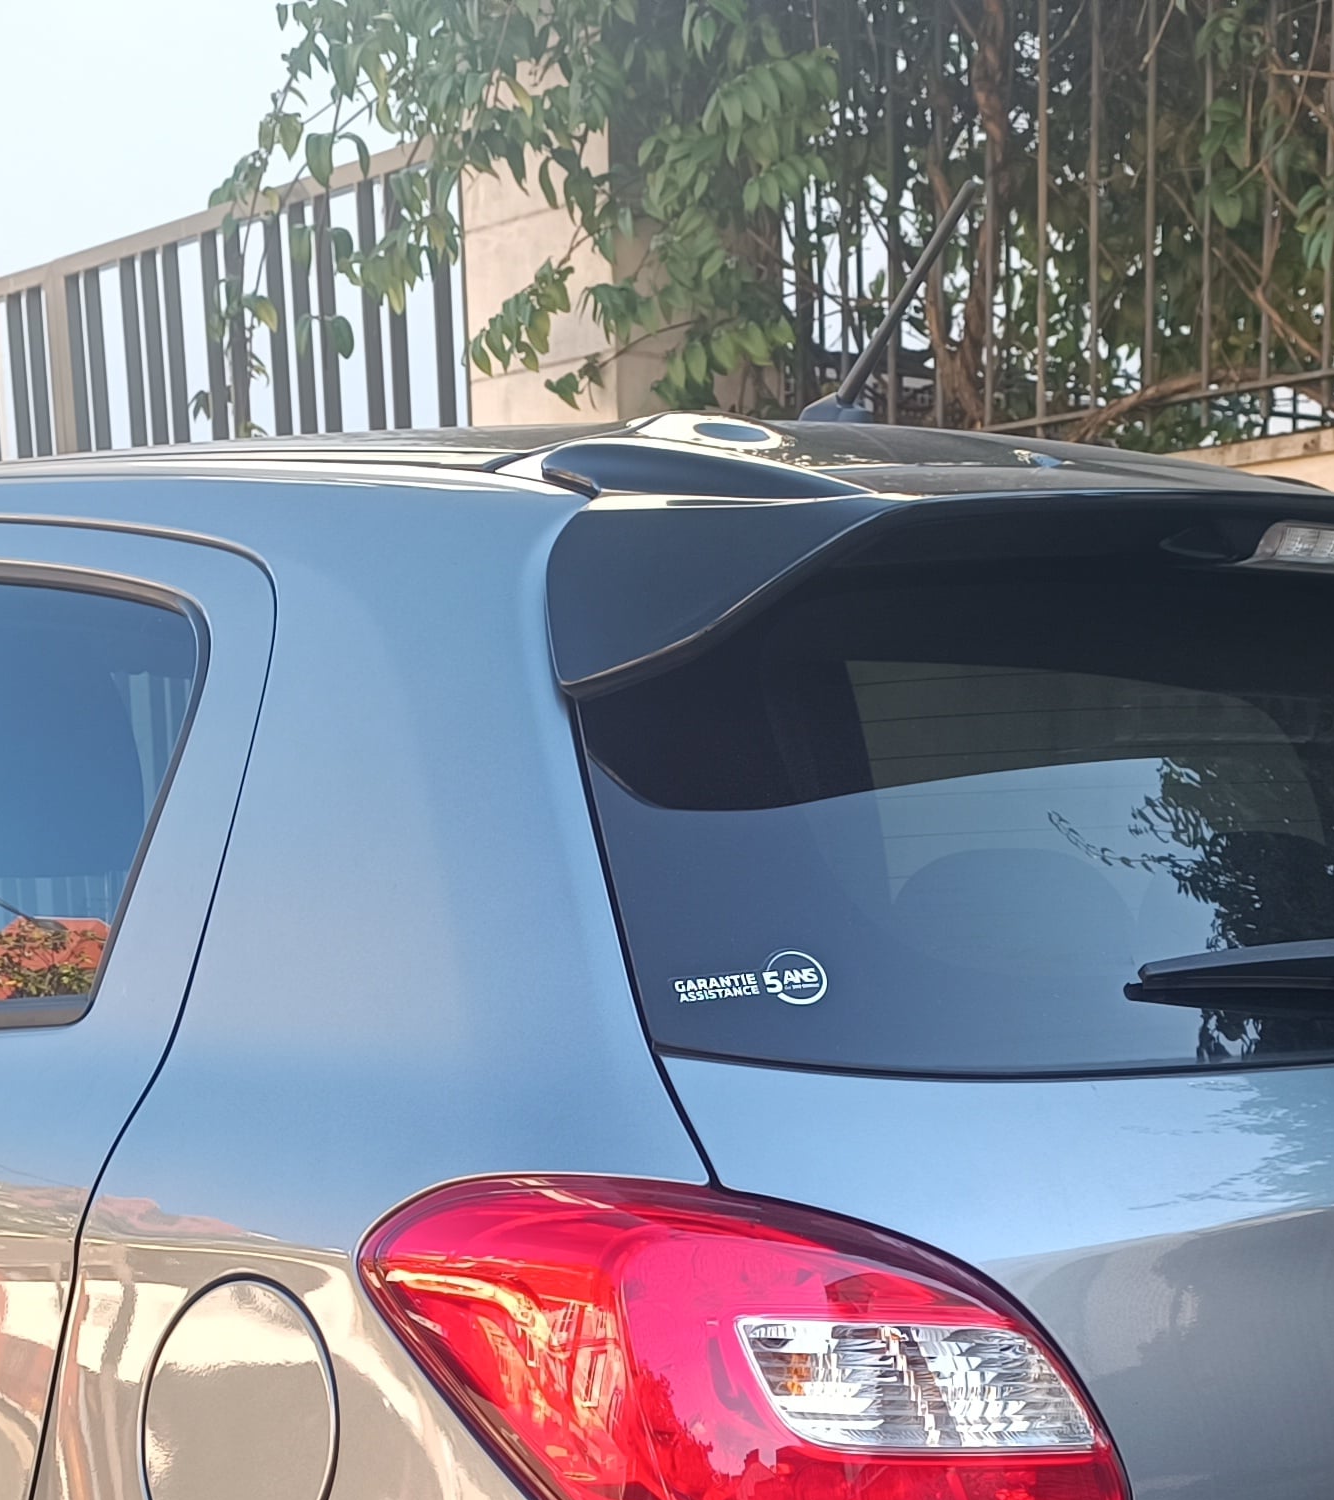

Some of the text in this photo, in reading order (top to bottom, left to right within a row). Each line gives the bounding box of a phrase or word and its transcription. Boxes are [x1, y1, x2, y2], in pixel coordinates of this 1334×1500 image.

[674, 967, 819, 993] GARANTIE 5 ANS
[679, 984, 760, 1003] ASSISTANCE
